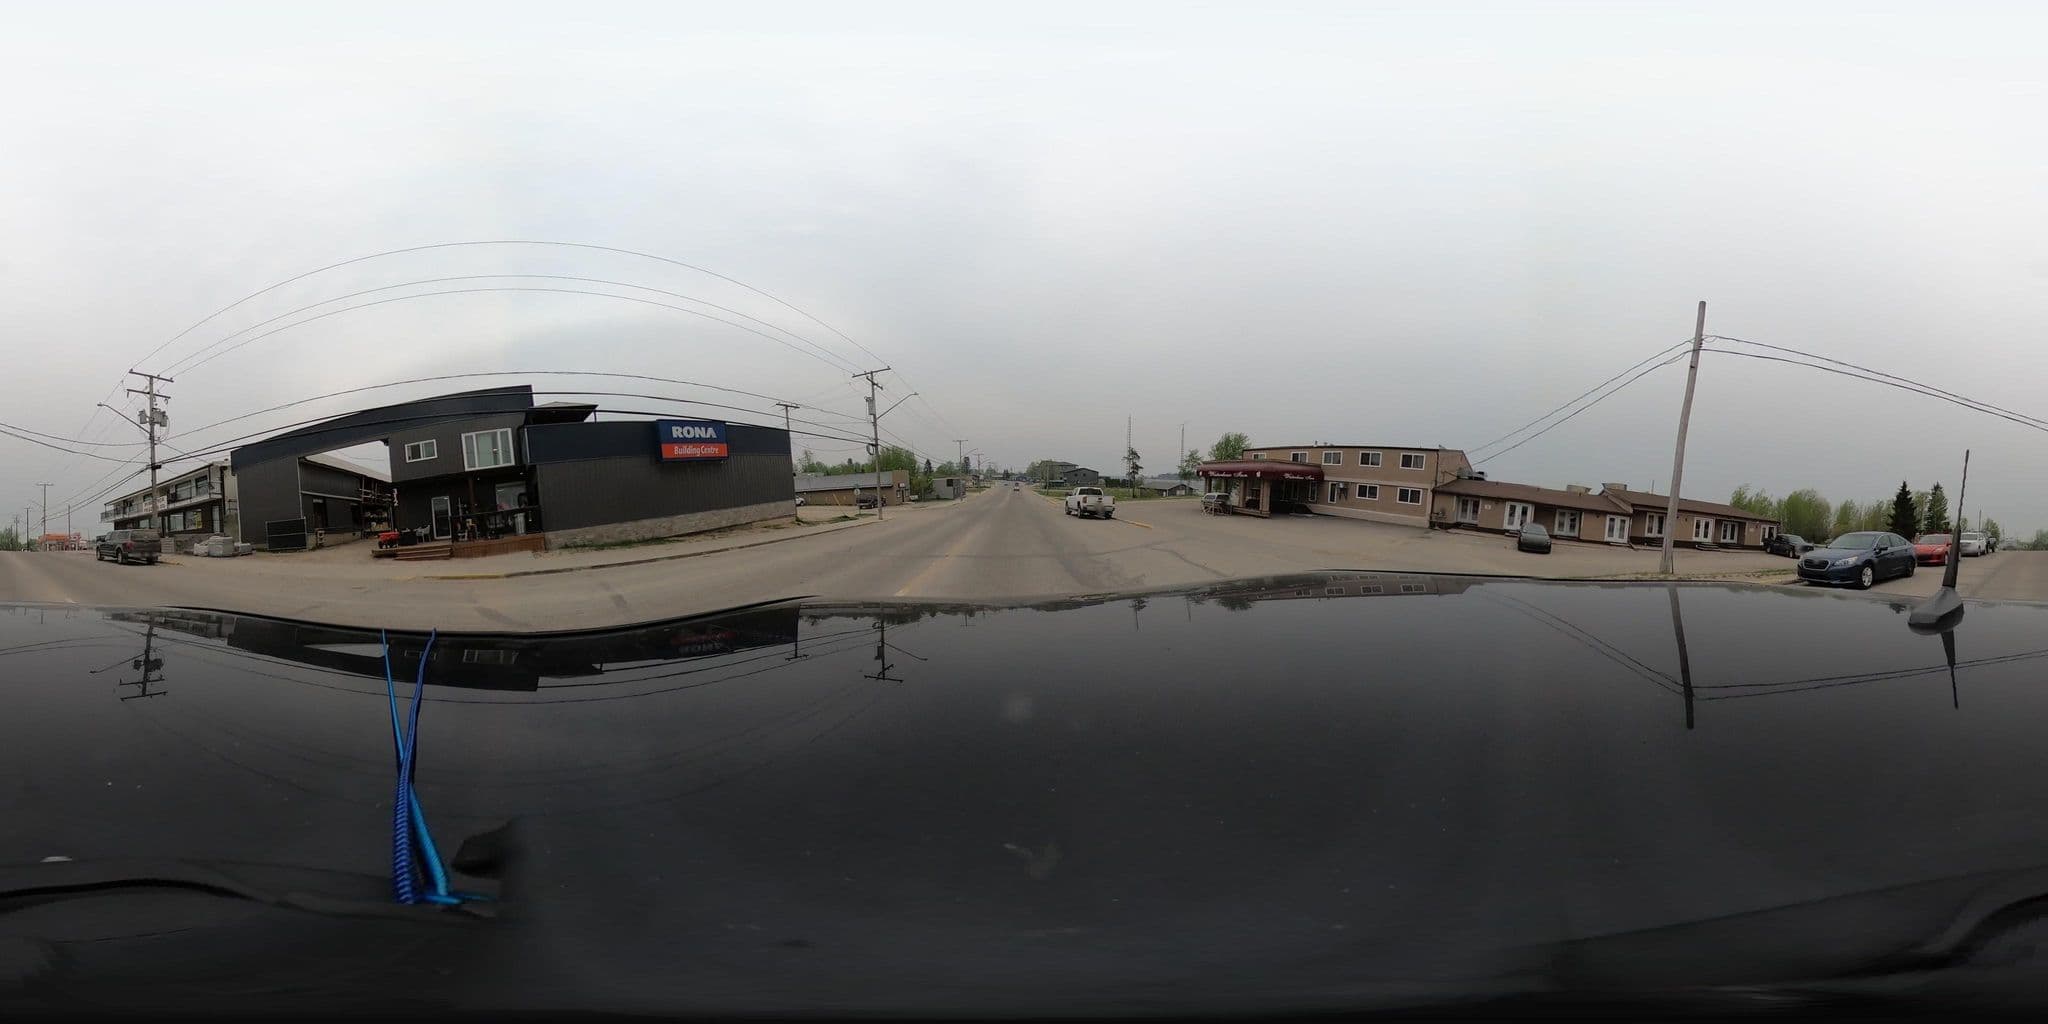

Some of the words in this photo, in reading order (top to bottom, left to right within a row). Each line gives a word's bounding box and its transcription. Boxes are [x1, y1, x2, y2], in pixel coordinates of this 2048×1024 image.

[671, 426, 717, 438] RONA
[674, 445, 700, 457] Building
[701, 445, 719, 454] Centre
